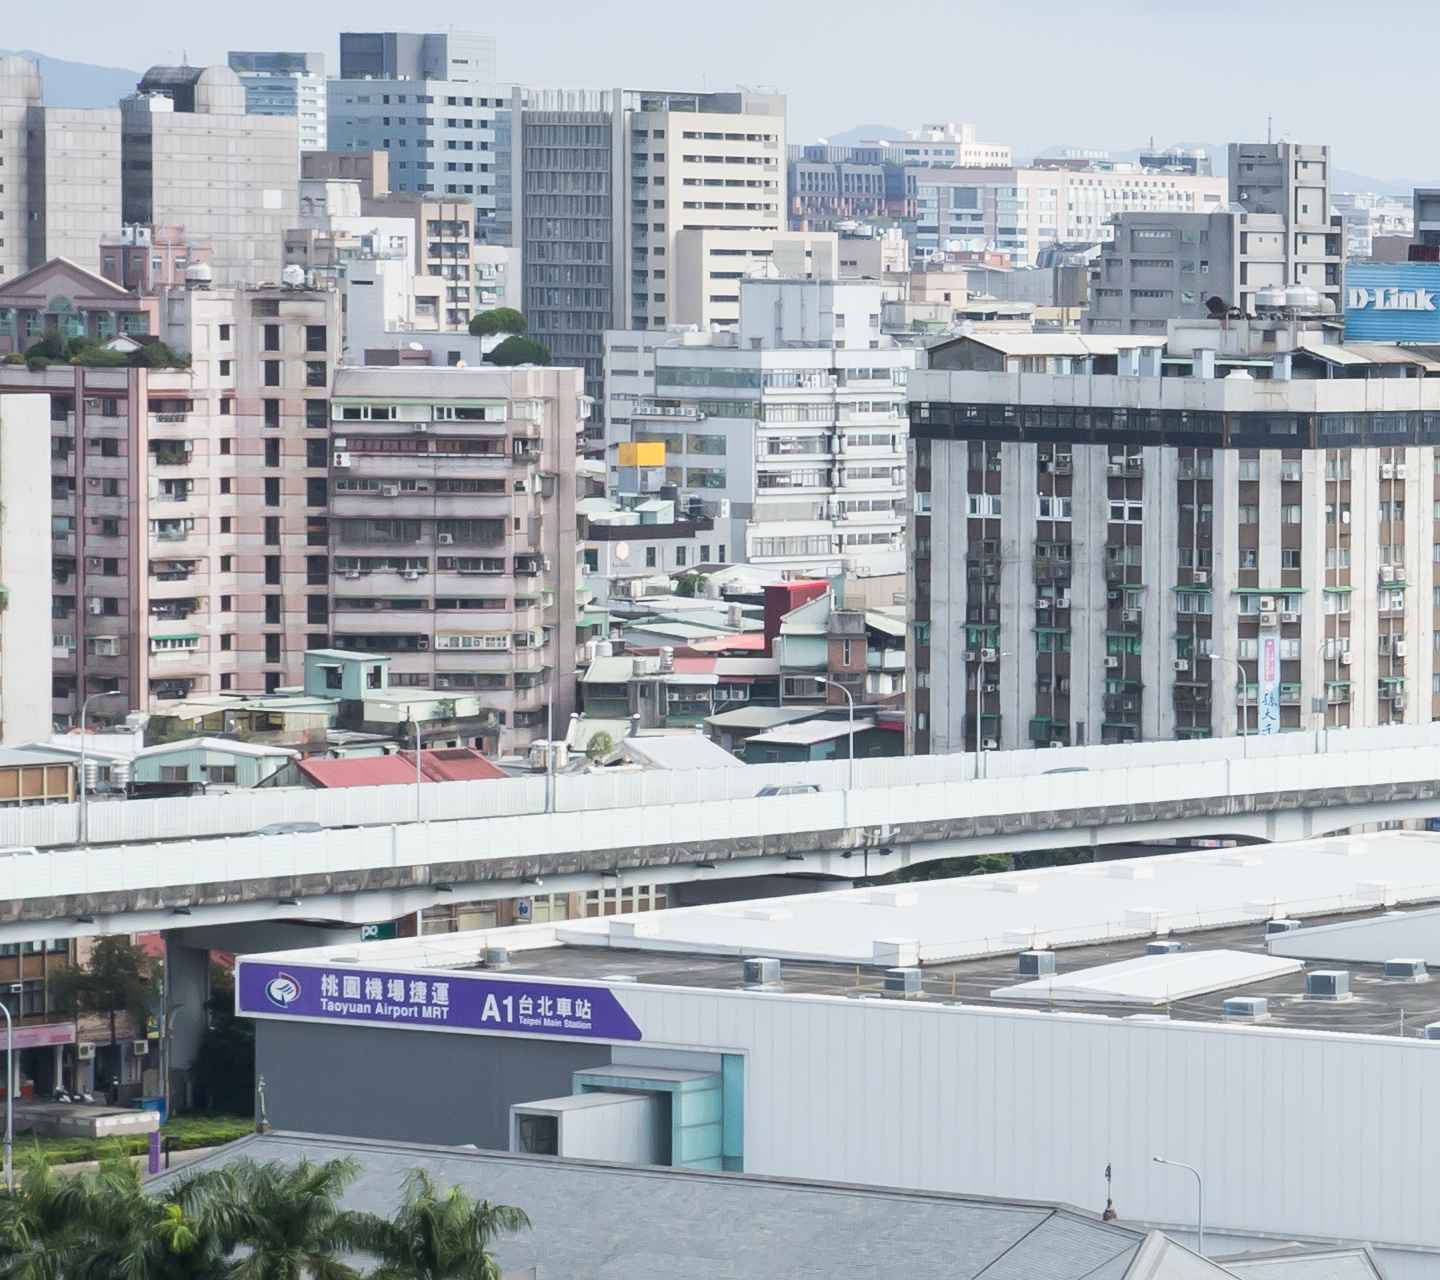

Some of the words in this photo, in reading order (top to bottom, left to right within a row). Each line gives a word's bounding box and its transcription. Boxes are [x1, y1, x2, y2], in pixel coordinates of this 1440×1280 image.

[1348, 286, 1437, 312] D-Link
[1261, 691, 1278, 735] 孫大千
[319, 997, 372, 1015] Taoyuan
[374, 1002, 419, 1019] Airport
[421, 1005, 450, 1020] MRT
[518, 1015, 541, 1027] Taipei
[542, 1017, 562, 1027] Main
[562, 1019, 592, 1030] Station
[320, 973, 450, 1007] 桃園機場捷運
[480, 992, 515, 1023] A1
[518, 993, 593, 1020] 台北車站
